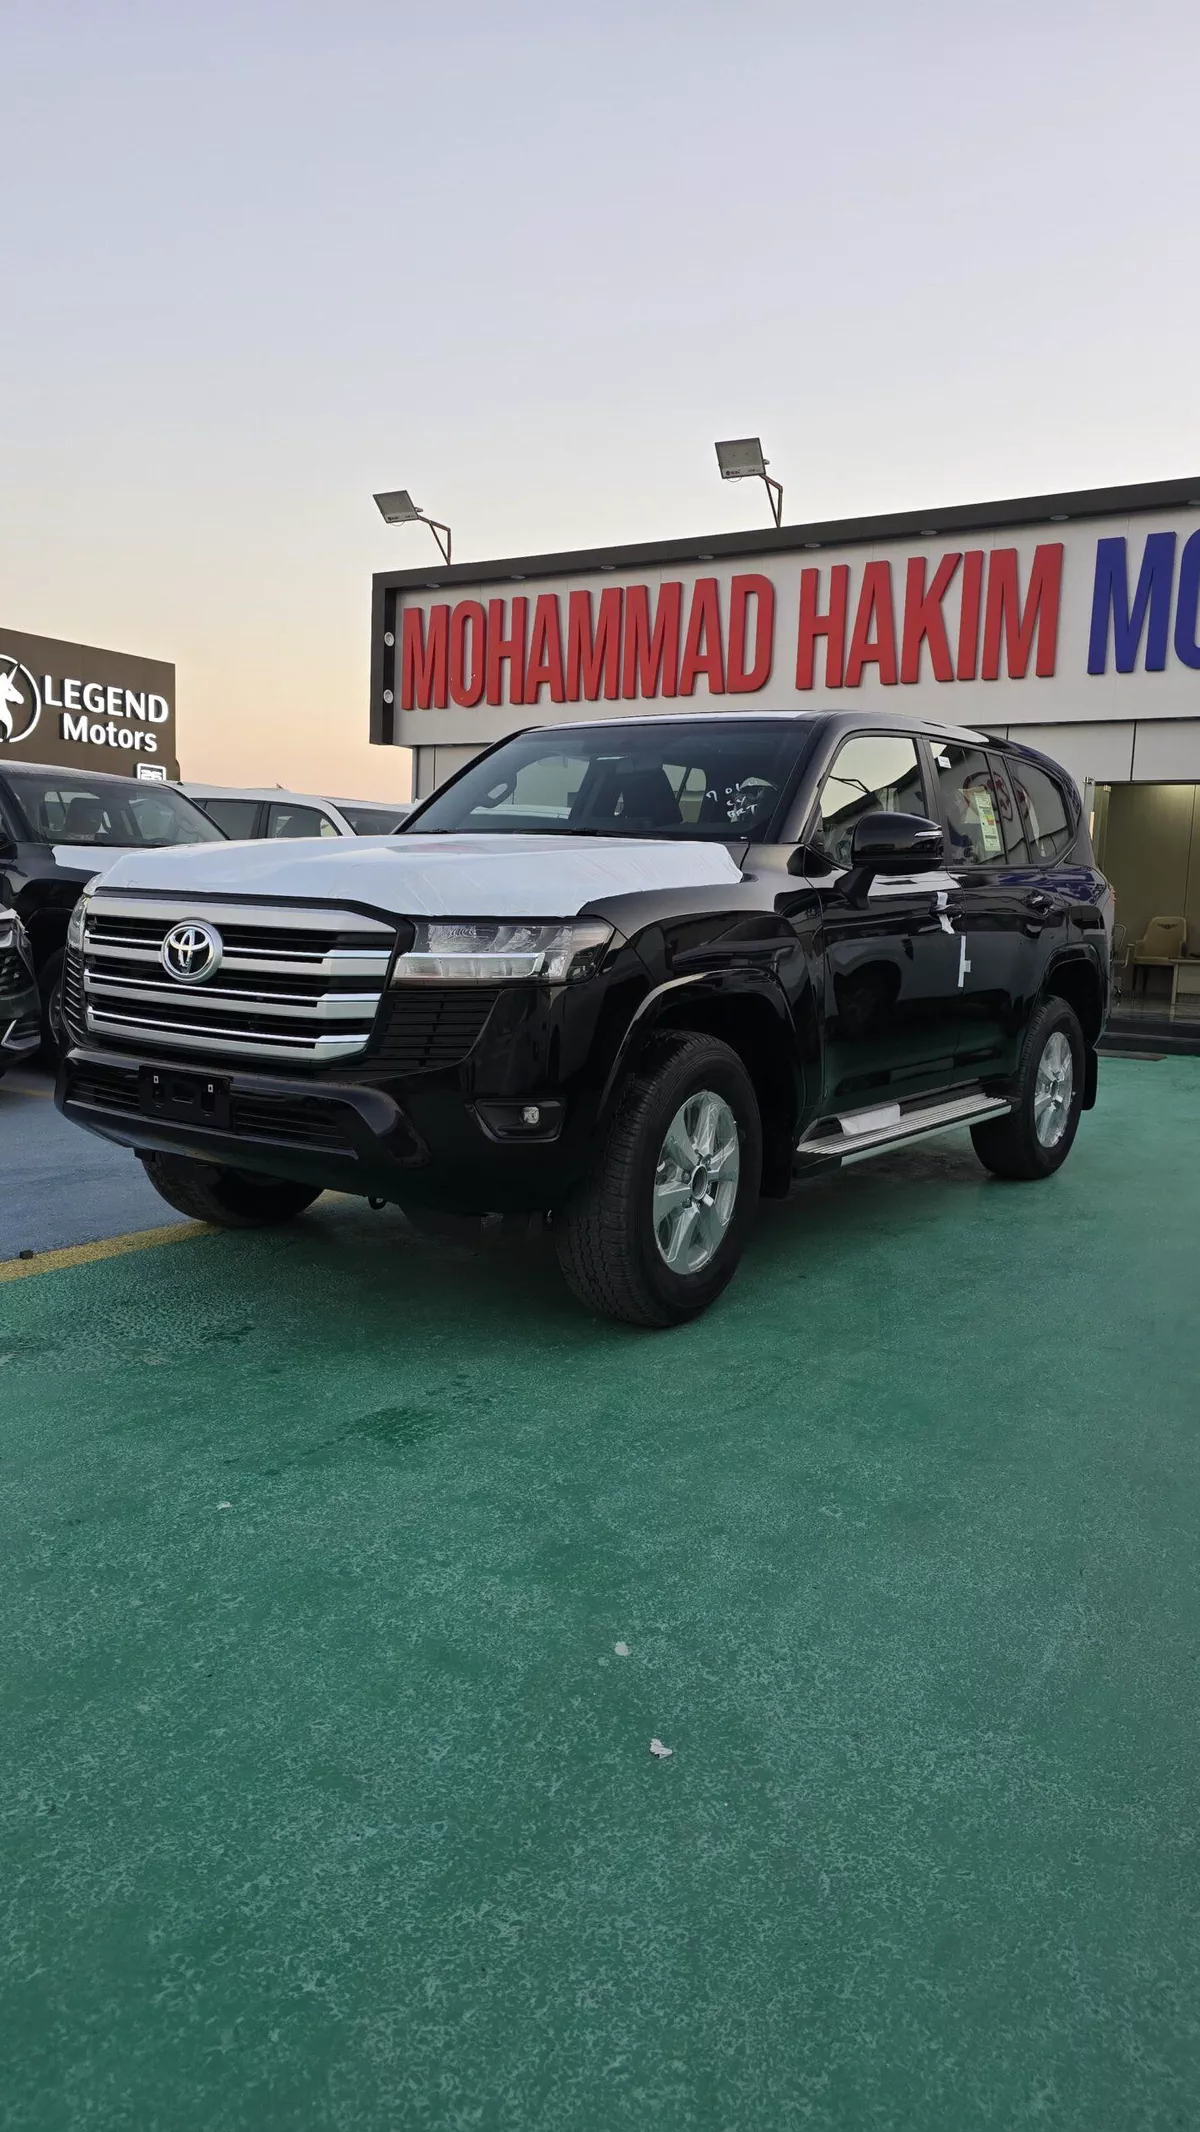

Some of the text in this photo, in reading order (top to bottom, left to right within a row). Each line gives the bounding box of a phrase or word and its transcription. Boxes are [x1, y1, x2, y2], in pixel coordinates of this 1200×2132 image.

[402, 573, 775, 710] MOHAMMAD
[795, 542, 1064, 691] HAKIM
[44, 674, 169, 723] LEGEND
[63, 712, 158, 753] Motors
